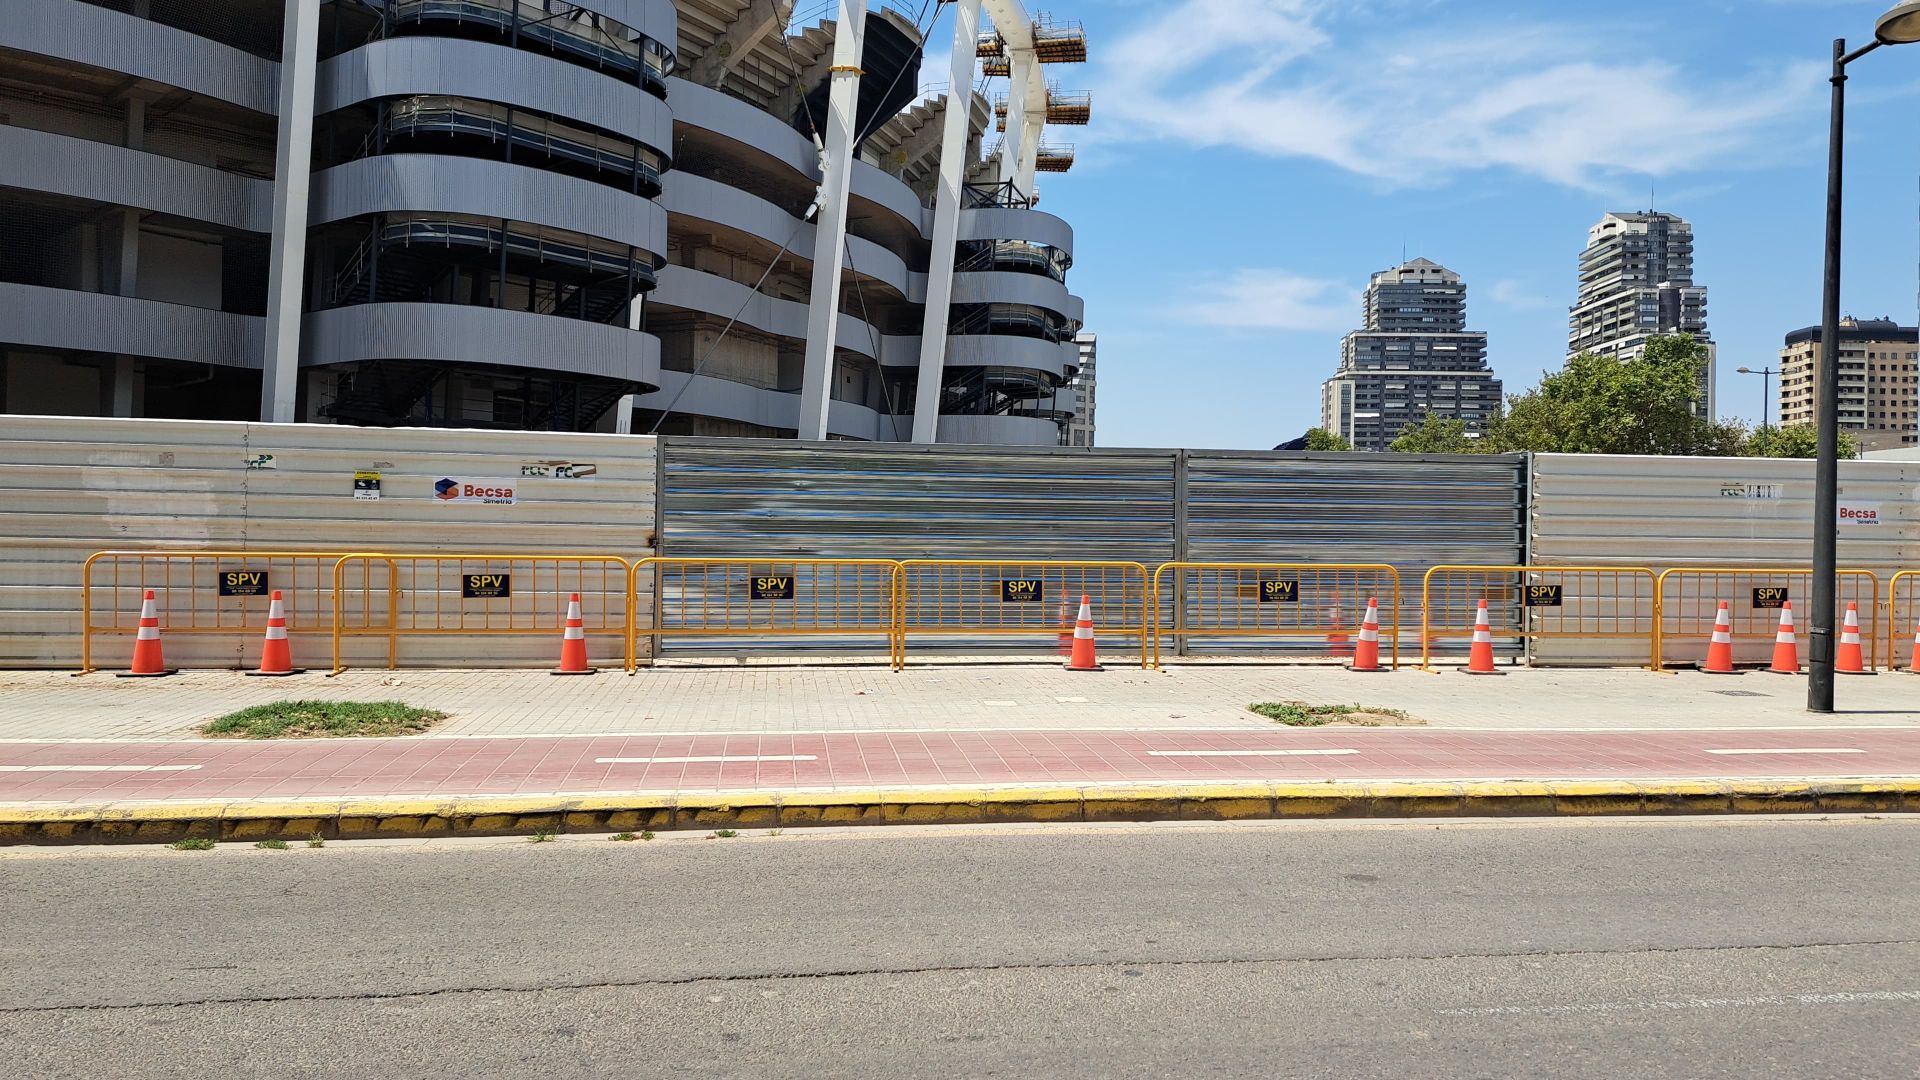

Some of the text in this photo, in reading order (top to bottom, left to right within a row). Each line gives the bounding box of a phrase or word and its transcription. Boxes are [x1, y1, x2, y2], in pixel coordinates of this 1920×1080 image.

[464, 484, 513, 498] Becsa
[1839, 507, 1877, 519] Becsa
[227, 572, 261, 586] SPV
[470, 575, 503, 588] SPV
[757, 578, 788, 590] SPV
[1008, 580, 1037, 593] SPV
[1265, 581, 1293, 593] SPV
[1530, 586, 1556, 597] SPV
[1758, 588, 1783, 600] SPV
